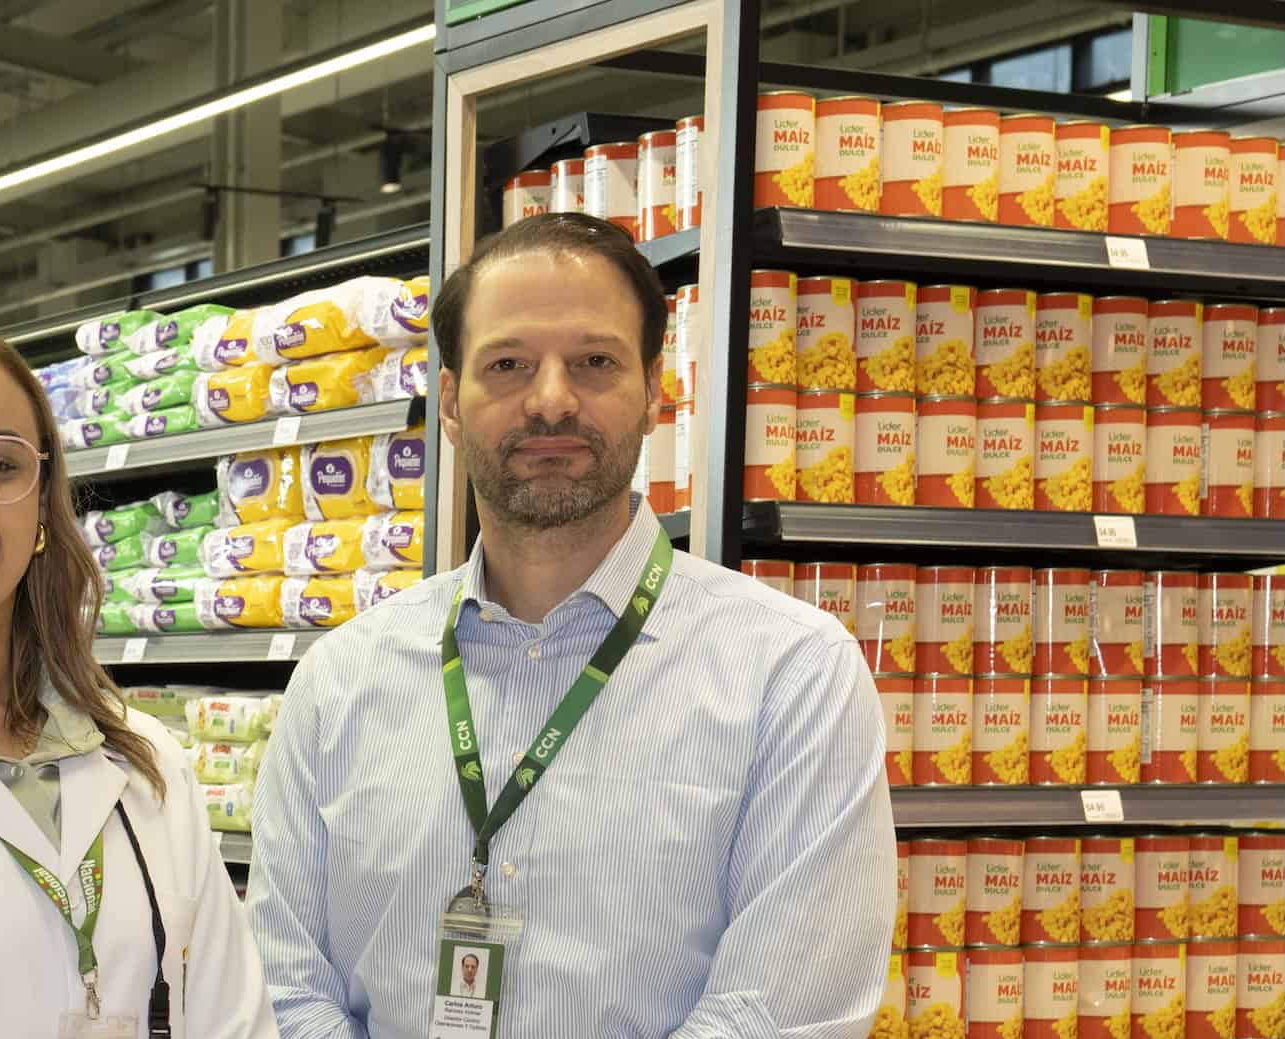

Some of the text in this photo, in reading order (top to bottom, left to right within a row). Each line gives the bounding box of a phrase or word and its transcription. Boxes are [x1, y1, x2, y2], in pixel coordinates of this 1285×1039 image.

[773, 128, 810, 144] MAÍZ
[839, 134, 876, 149] MAÍZ
[1016, 152, 1052, 166] MAÍZ
[1057, 157, 1098, 172] MAÍZ
[1132, 161, 1166, 176] MAÍZ
[861, 316, 900, 330] MAÍZ
[983, 323, 1021, 339] MAÍZ
[1154, 336, 1190, 350] MAÍZ
[796, 426, 835, 443] MAÍZ
[878, 432, 911, 446] MAÍZ
[983, 435, 1021, 450] MAÍZ
[1041, 438, 1079, 453] MAÍZ
[1108, 440, 1141, 455] MAÍZ
[645, 564, 662, 590] CCN
[941, 600, 972, 615] MAÍZ
[997, 601, 1030, 615] MAÍZ
[932, 711, 966, 726] MAÍZ
[984, 710, 1020, 725] MAÍZ
[1046, 712, 1081, 727] MAÍZ
[1212, 712, 1244, 726] MAÍZ
[459, 720, 472, 750] CCN
[536, 727, 562, 758] CCN
[985, 874, 1020, 888] MAÍZ
[1036, 871, 1073, 886] MAÍZ
[1139, 974, 1175, 989] MAÍZ
